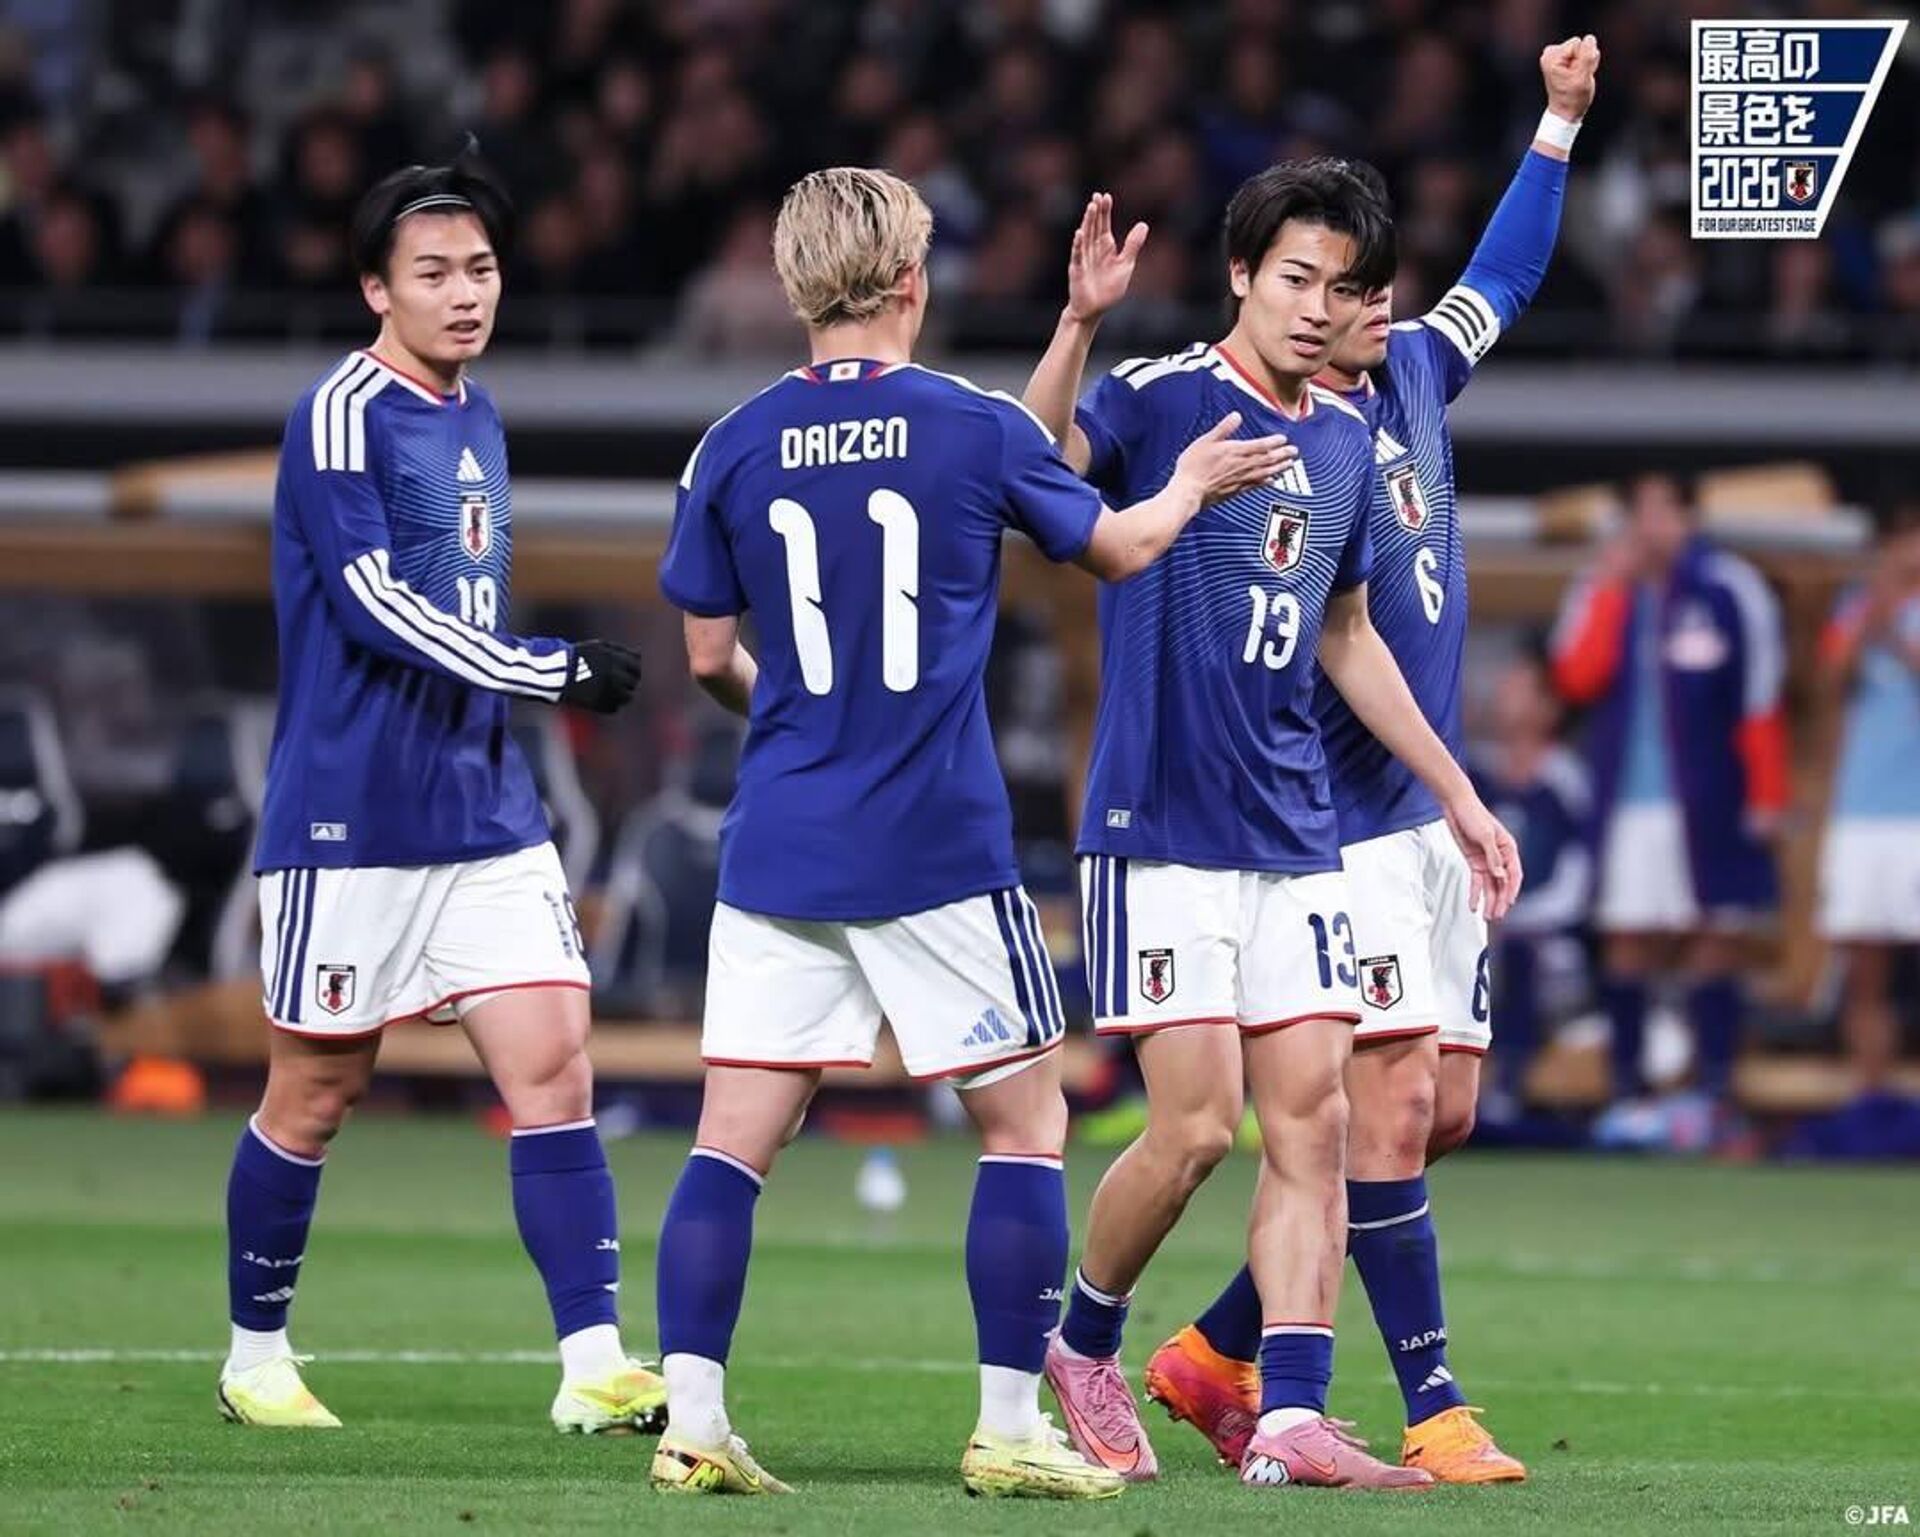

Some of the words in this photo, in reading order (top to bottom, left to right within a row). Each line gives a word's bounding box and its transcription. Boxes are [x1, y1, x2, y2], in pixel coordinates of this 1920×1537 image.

[781, 416, 908, 469] DAIZEN
[768, 488, 919, 695] 11
[1414, 546, 1445, 625] 6
[1243, 585, 1300, 670] 13
[1307, 910, 1358, 989] 13
